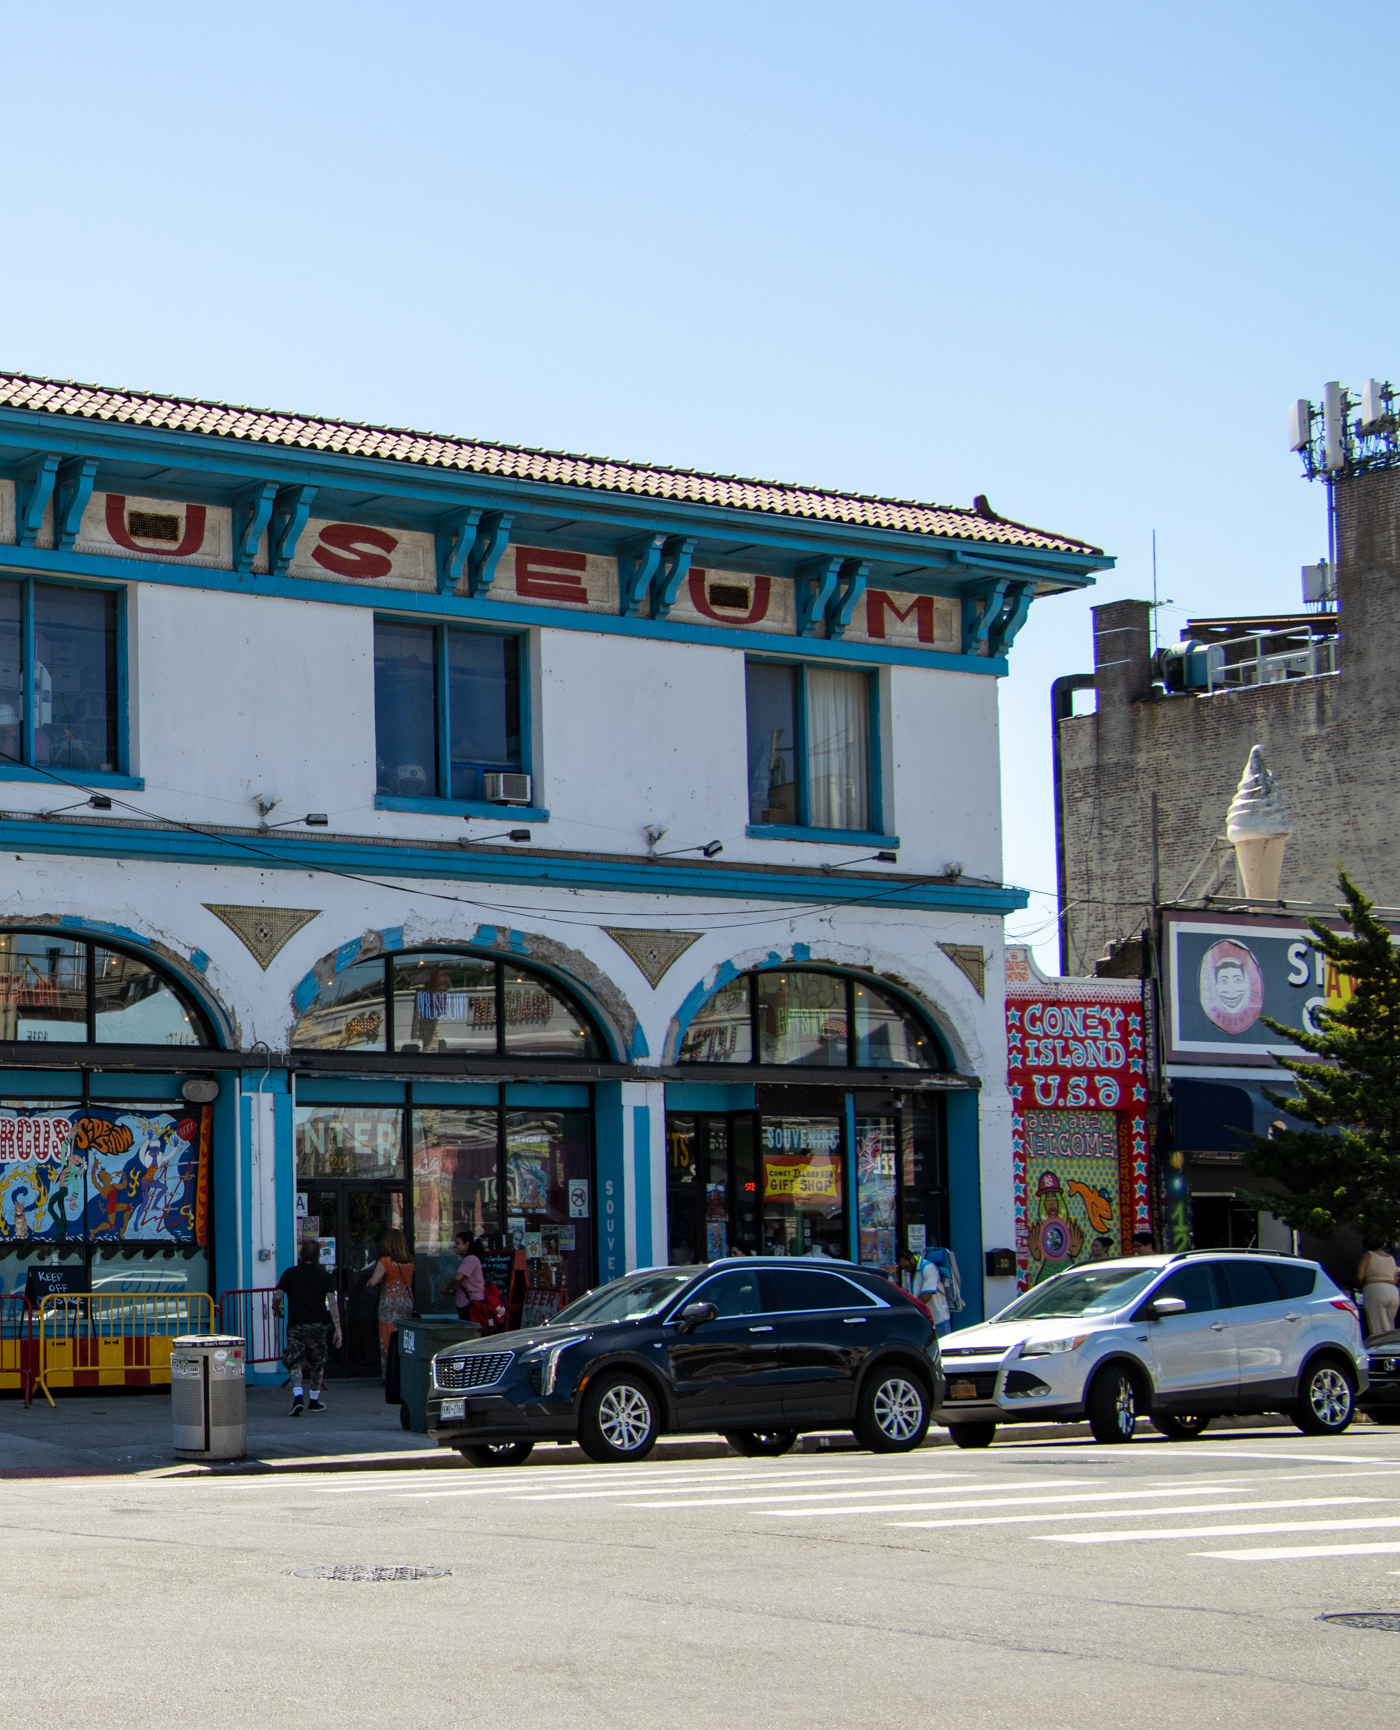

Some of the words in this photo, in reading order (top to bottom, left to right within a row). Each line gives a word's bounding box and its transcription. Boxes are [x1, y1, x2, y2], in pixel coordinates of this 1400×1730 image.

[417, 991, 468, 1020] MUSEUM
[1024, 1003, 1124, 1038] CONEY
[1211, 1006, 1254, 1027] PRESENTS
[766, 1128, 837, 1149] SOUVENIRS
[770, 1179, 794, 1191] GIFT
[800, 1179, 832, 1192] SHOP
[296, 1196, 305, 1210] A
[38, 1271, 63, 1282] KEEP
[49, 1284, 68, 1293] OFF
[525, 1289, 557, 1308] BEER
